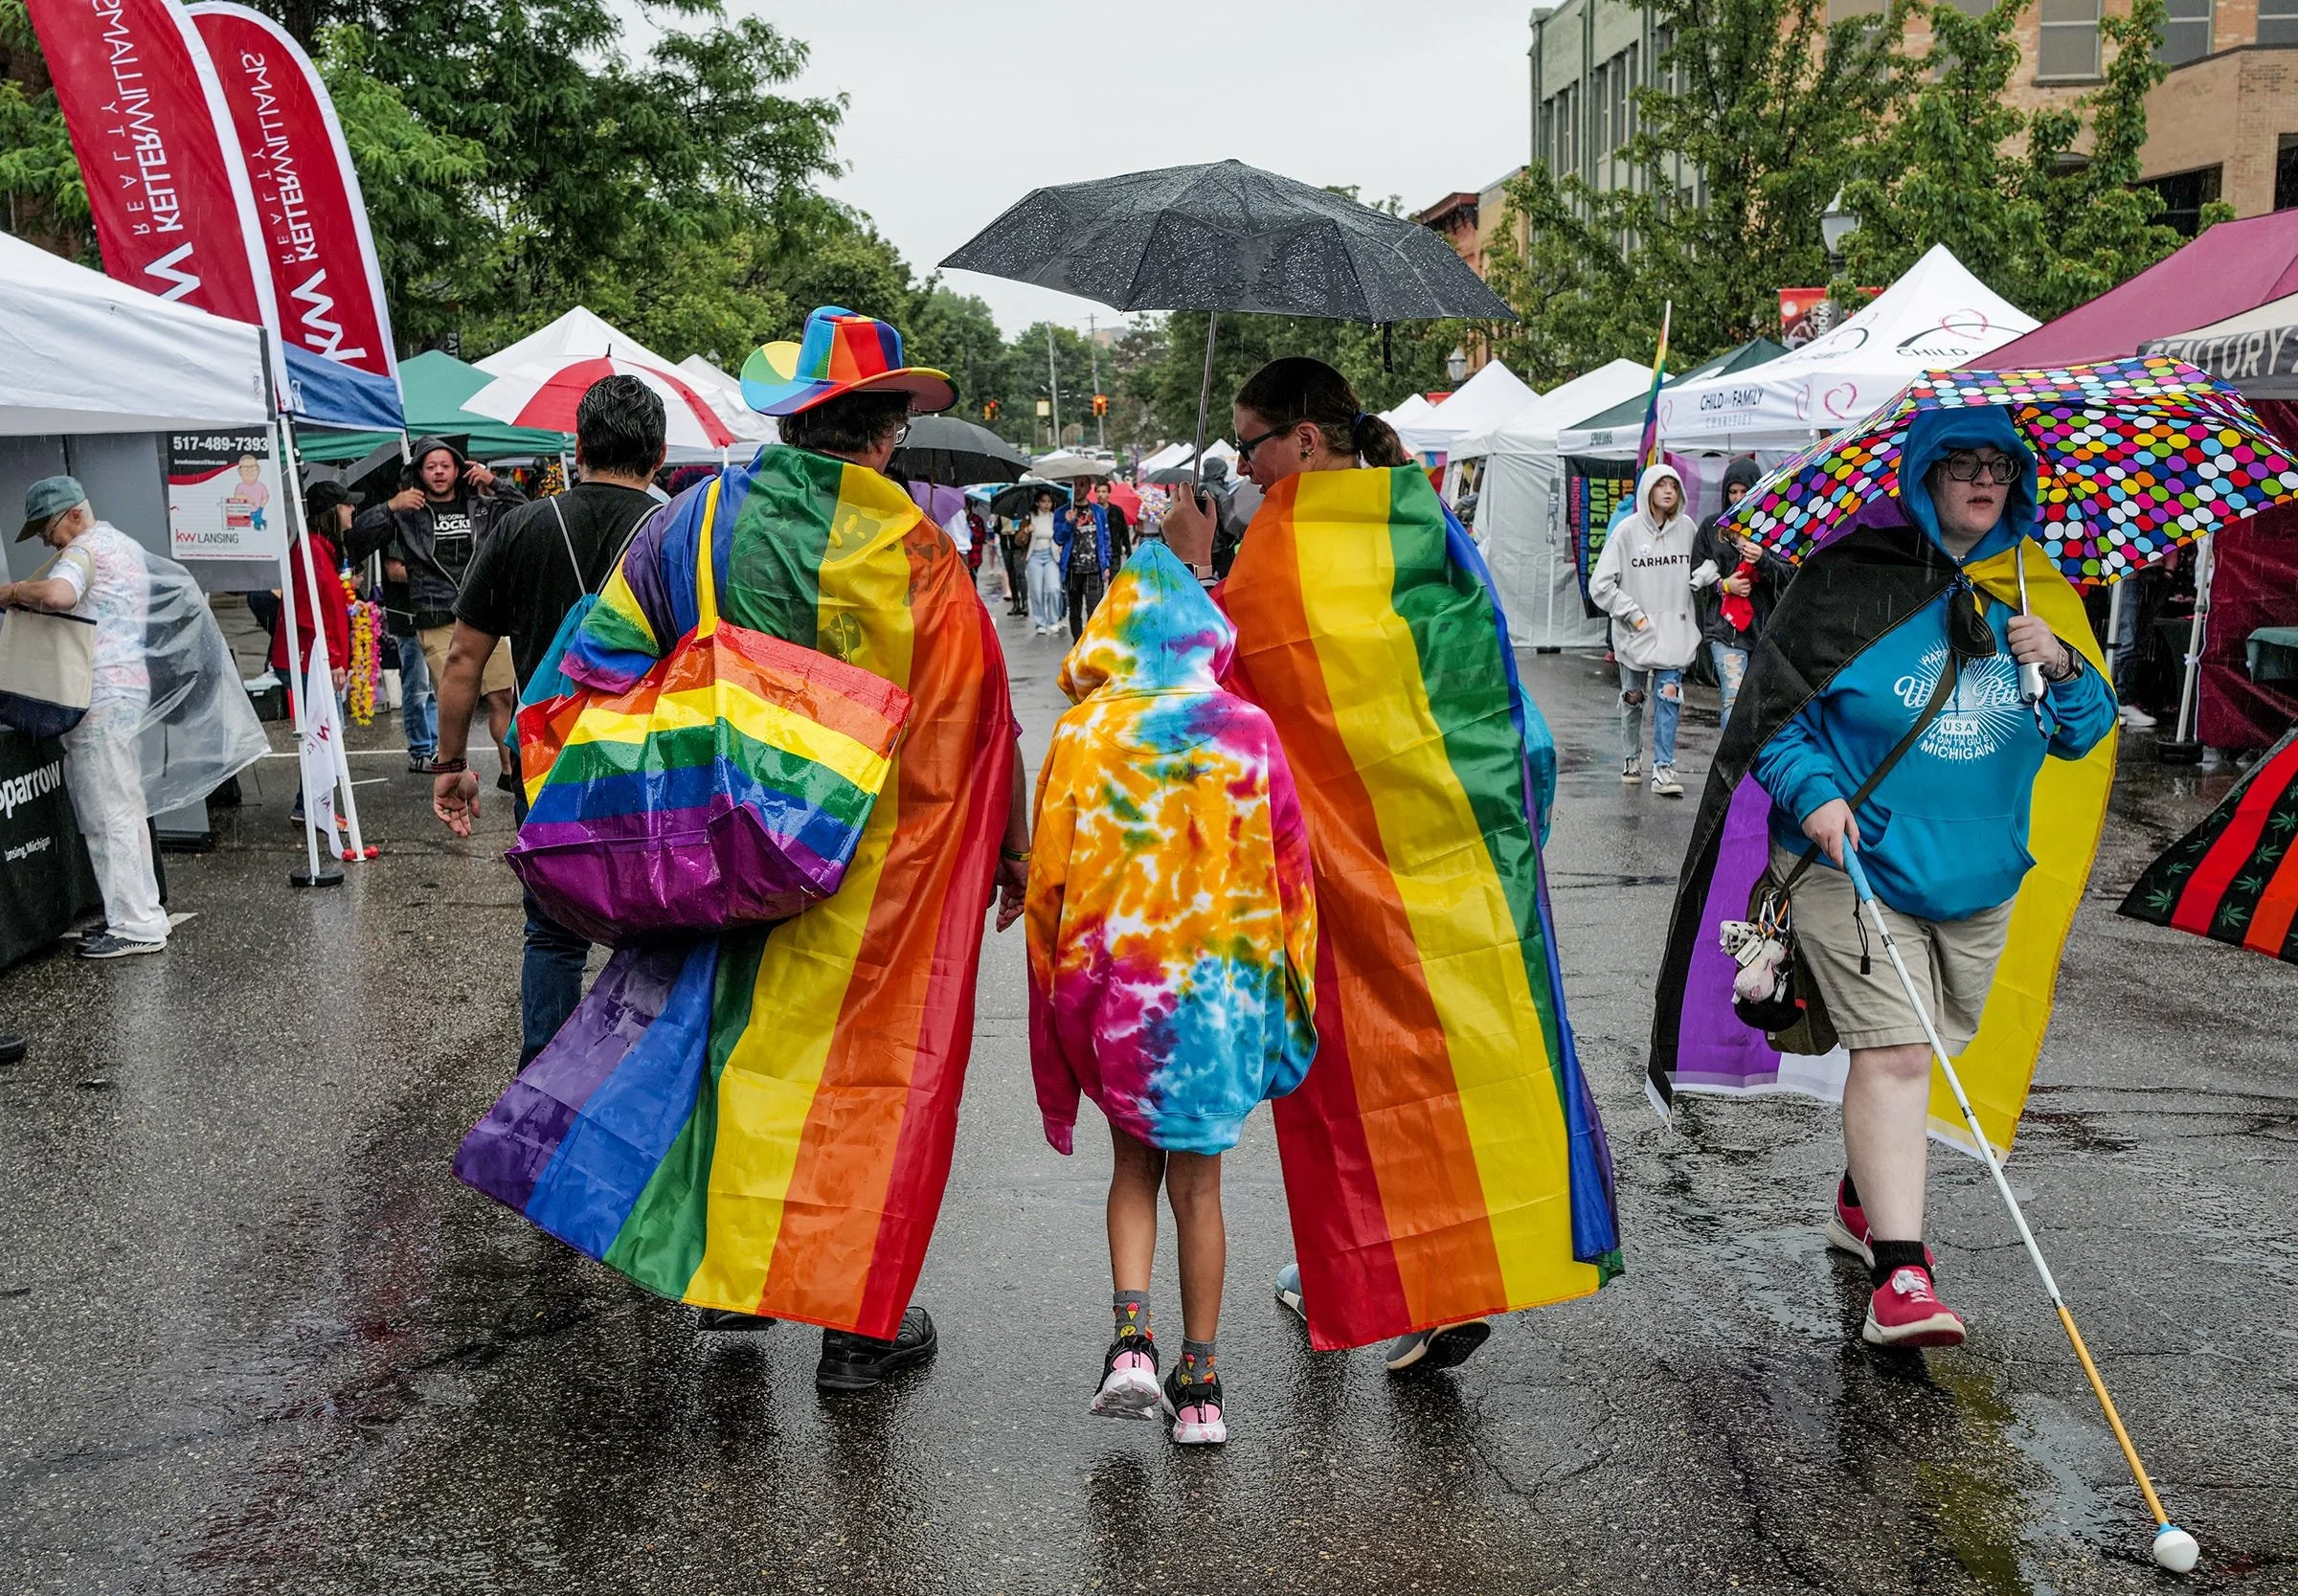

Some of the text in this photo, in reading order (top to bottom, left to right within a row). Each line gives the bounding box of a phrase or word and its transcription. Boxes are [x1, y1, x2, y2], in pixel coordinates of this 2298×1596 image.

[2147, 326, 2293, 379] NTURY
[172, 437, 269, 452] 517-489-7393
[1571, 476, 1581, 526] KINDNESS
[1589, 477, 1609, 523] LOVE
[197, 533, 239, 544] LANSING
[1588, 528, 1607, 549] IS
[1632, 555, 1690, 568] CARHARTT
[1922, 649, 1949, 665] HAPP
[1972, 676, 2019, 706] Riv
[1943, 722, 1973, 731] USA
[1926, 731, 1991, 747] MONTAGUE
[1921, 740, 1995, 760] MICHIGAN
